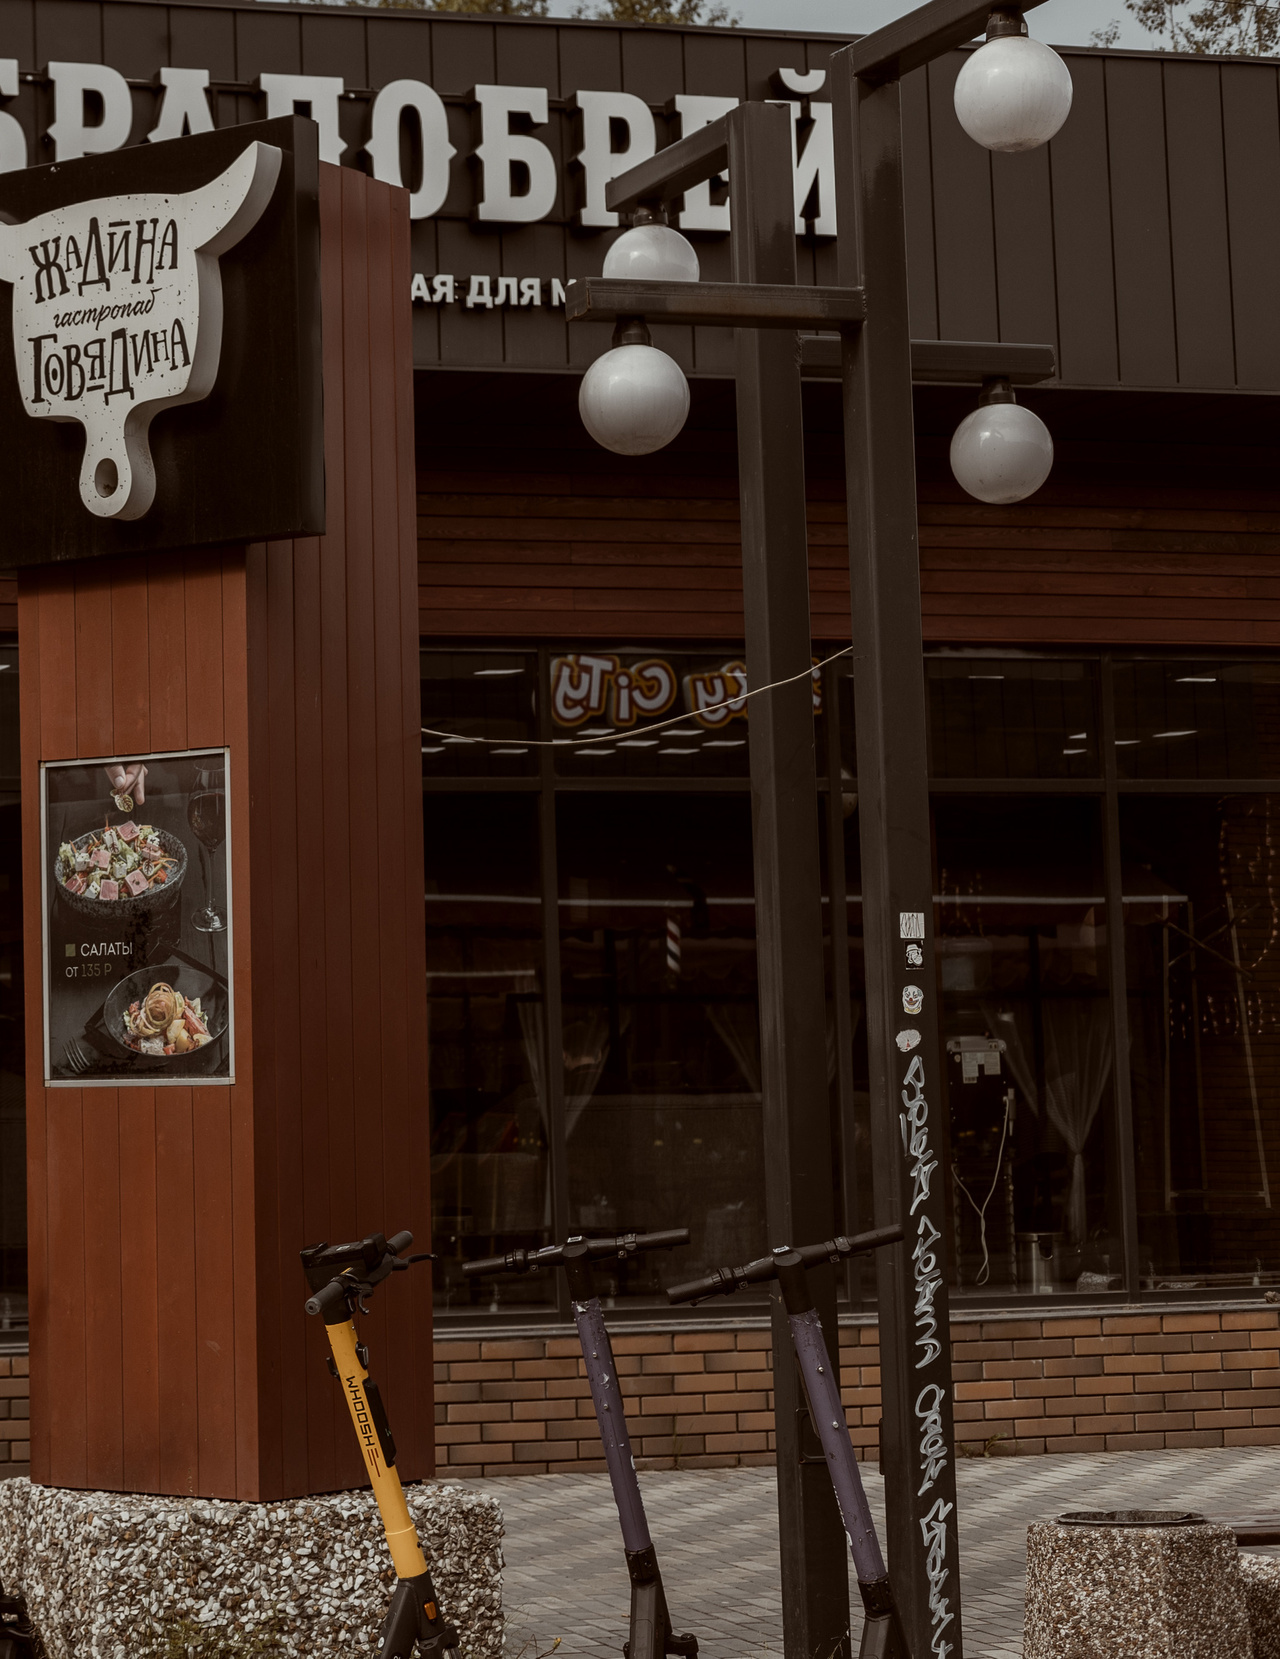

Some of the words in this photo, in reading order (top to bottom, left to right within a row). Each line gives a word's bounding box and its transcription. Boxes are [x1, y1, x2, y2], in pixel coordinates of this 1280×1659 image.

[29, 217, 178, 304] ЖАДИНА
[53, 288, 162, 330] гастропаб
[466, 275, 542, 309] ДЛЯ
[28, 318, 191, 406] ГОВЯДИНА
[80, 942, 133, 956] САЛАТЫ
[81, 963, 101, 977] 135
[345, 1375, 375, 1447] WHOOSH
